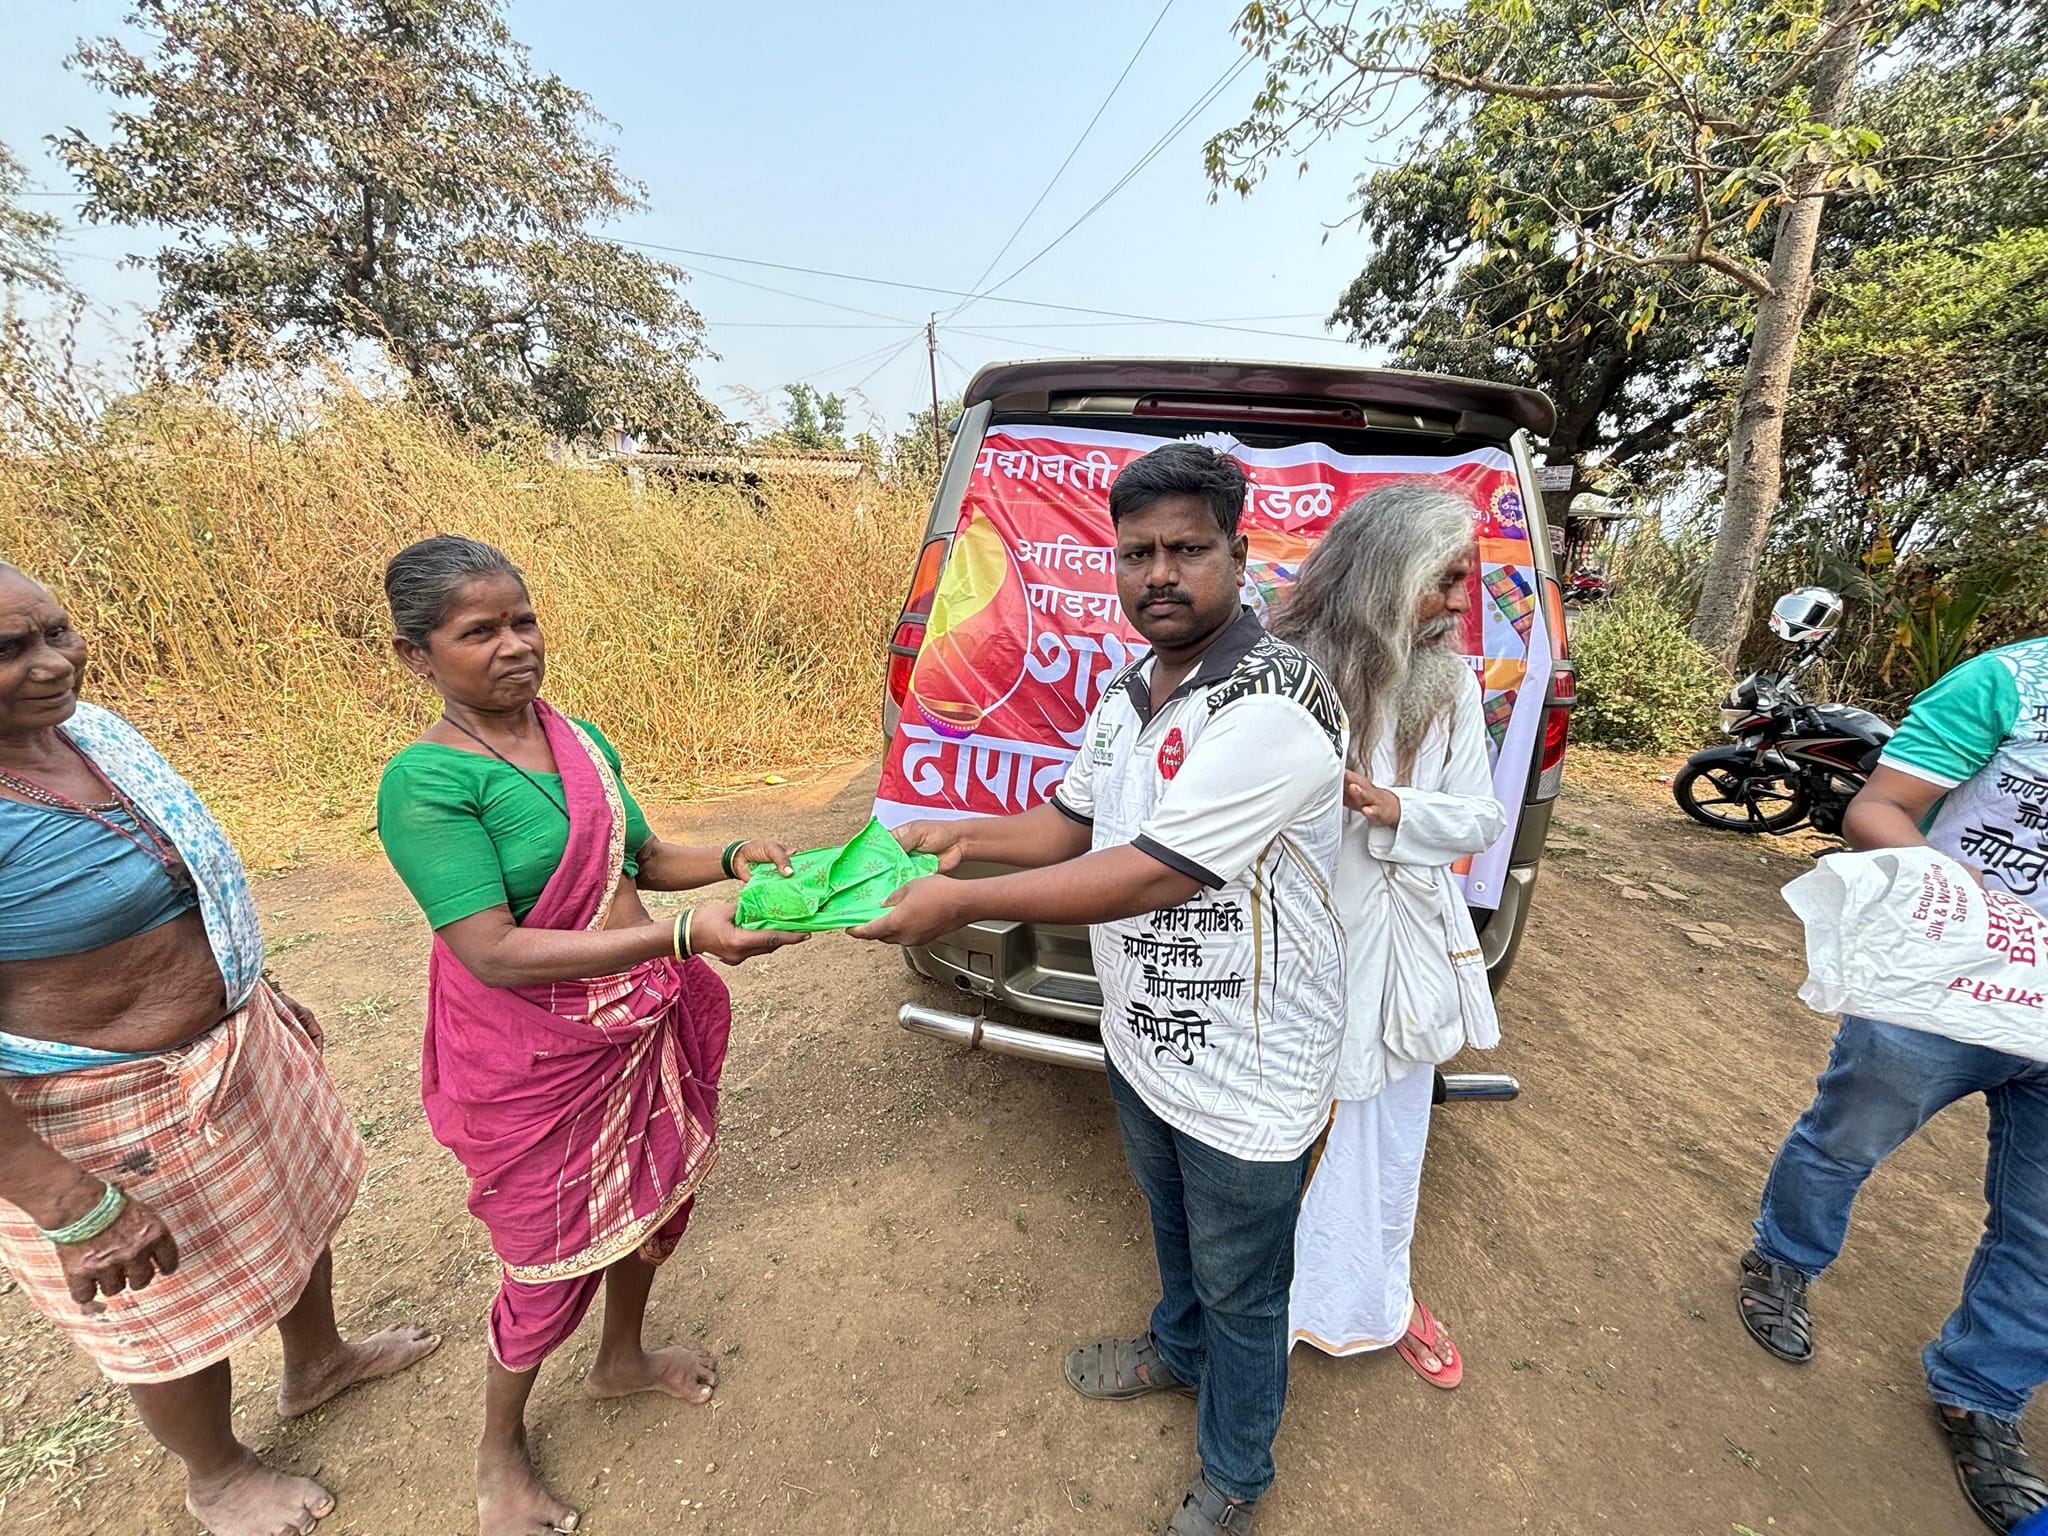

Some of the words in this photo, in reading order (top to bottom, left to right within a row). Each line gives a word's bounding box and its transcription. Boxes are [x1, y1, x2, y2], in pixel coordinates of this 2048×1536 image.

[1014, 533, 1117, 576] आदिवा
[1027, 583, 1121, 624] पाडया
[1960, 819, 2048, 896] नमोस्तु
[1933, 908, 1948, 918] &
[1951, 885, 1968, 923] Sarees
[1925, 919, 1945, 941] Silk
